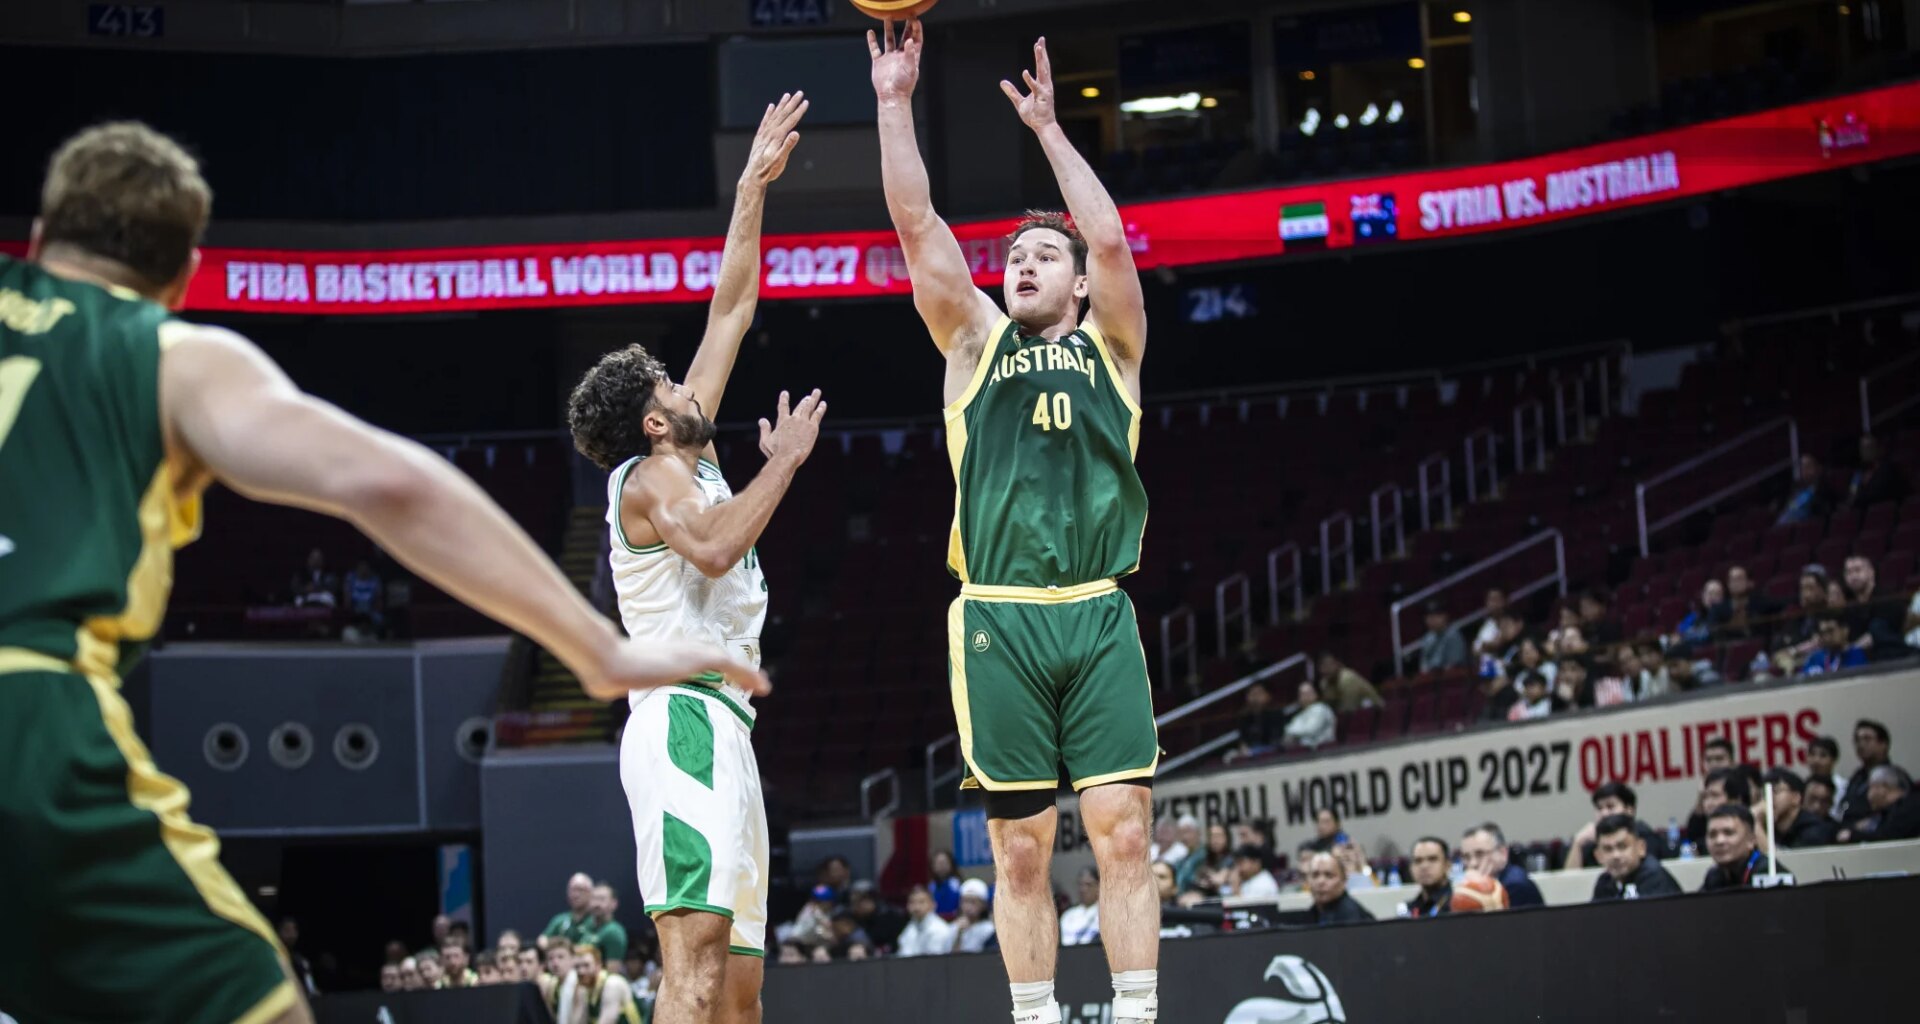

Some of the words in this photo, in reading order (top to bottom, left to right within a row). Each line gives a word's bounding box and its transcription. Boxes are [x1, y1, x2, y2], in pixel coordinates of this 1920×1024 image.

[96, 6, 156, 36] 413
[1418, 185, 1502, 231] SYRIA
[1502, 178, 1544, 219] VS.
[1546, 151, 1680, 212] AUSTRALIA
[227, 260, 309, 301] FIBA
[315, 257, 548, 302] BASKETBALL
[551, 252, 679, 296] WORLD
[765, 246, 860, 287] 2027
[1032, 391, 1072, 431] 40
[1282, 767, 1392, 827] WORLD
[1400, 756, 1469, 811] CUP
[1479, 740, 1571, 801] 2027
